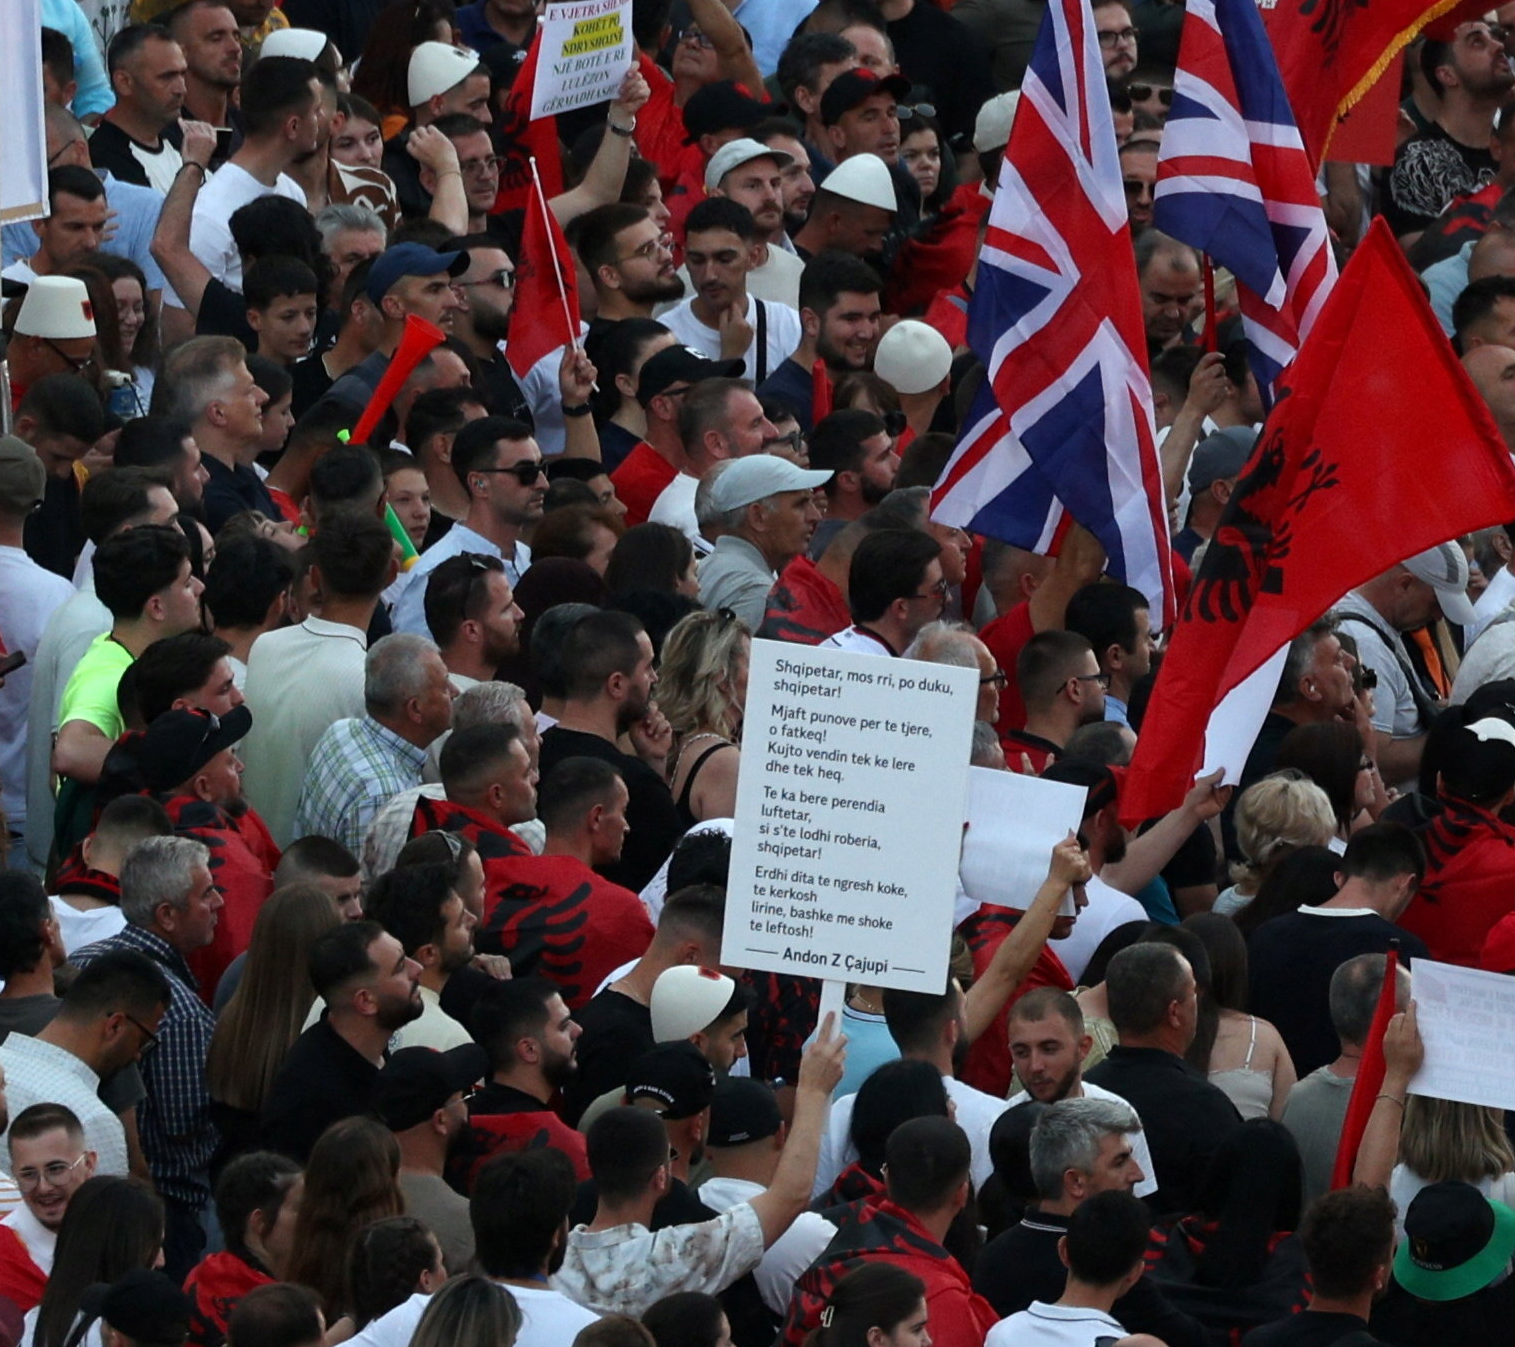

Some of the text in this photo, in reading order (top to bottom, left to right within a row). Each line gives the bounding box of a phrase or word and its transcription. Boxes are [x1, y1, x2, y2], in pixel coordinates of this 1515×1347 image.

[774, 680, 841, 699] shqipetar!
[776, 659, 953, 695] Shqipetar, mos rri, po duku,
[769, 725, 827, 742] o fatkeq!
[771, 705, 933, 738] Mjaft punove per te tjere,
[768, 742, 915, 771] Kujto vendin tek ke lere
[766, 760, 844, 782] dhe tek heq.
[764, 786, 885, 813] Te ka bere perendia
[761, 804, 812, 823] luftetar,
[759, 823, 881, 850] si s'te lodhi roberia,
[757, 841, 822, 860] shqipetar!
[754, 884, 818, 902] te kerkosh
[755, 866, 908, 897] Erdhi dita te ngresh koke,
[750, 920, 813, 938] te leftosh!
[752, 902, 893, 930] lirine, bashke me shoke
[783, 947, 888, 974] Andon Z Çajupi
